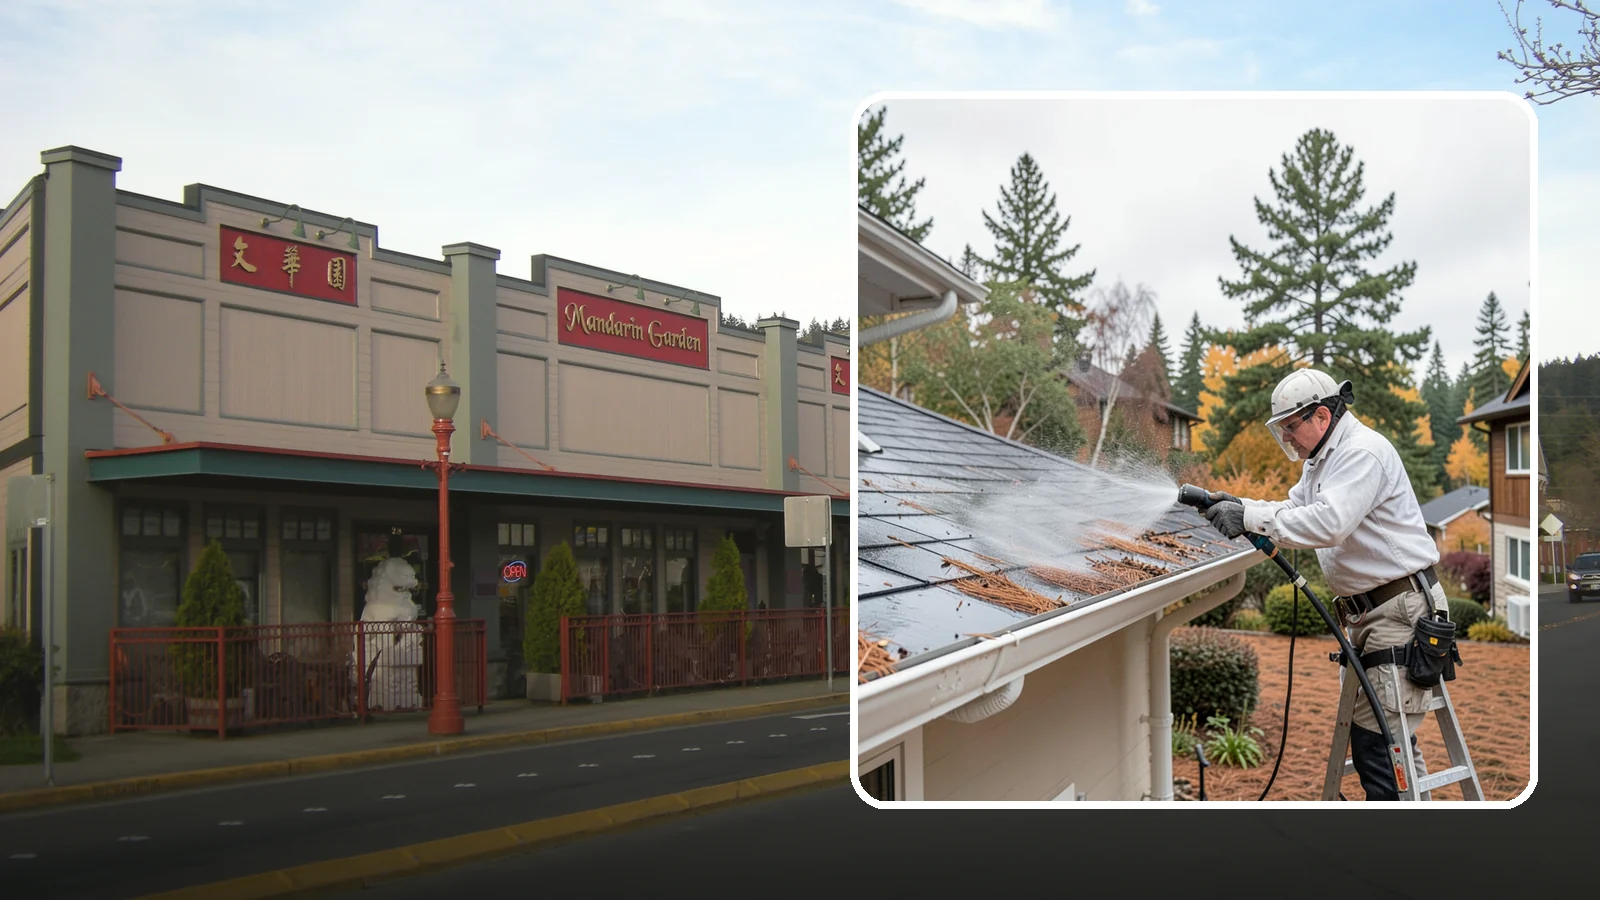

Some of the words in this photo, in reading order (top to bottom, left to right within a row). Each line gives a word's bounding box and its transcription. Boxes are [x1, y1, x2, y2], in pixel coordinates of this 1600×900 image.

[231, 236, 346, 290] 文華園
[565, 302, 644, 341] Mandarin
[648, 321, 702, 352] Garden
[503, 565, 527, 578] OPEN
